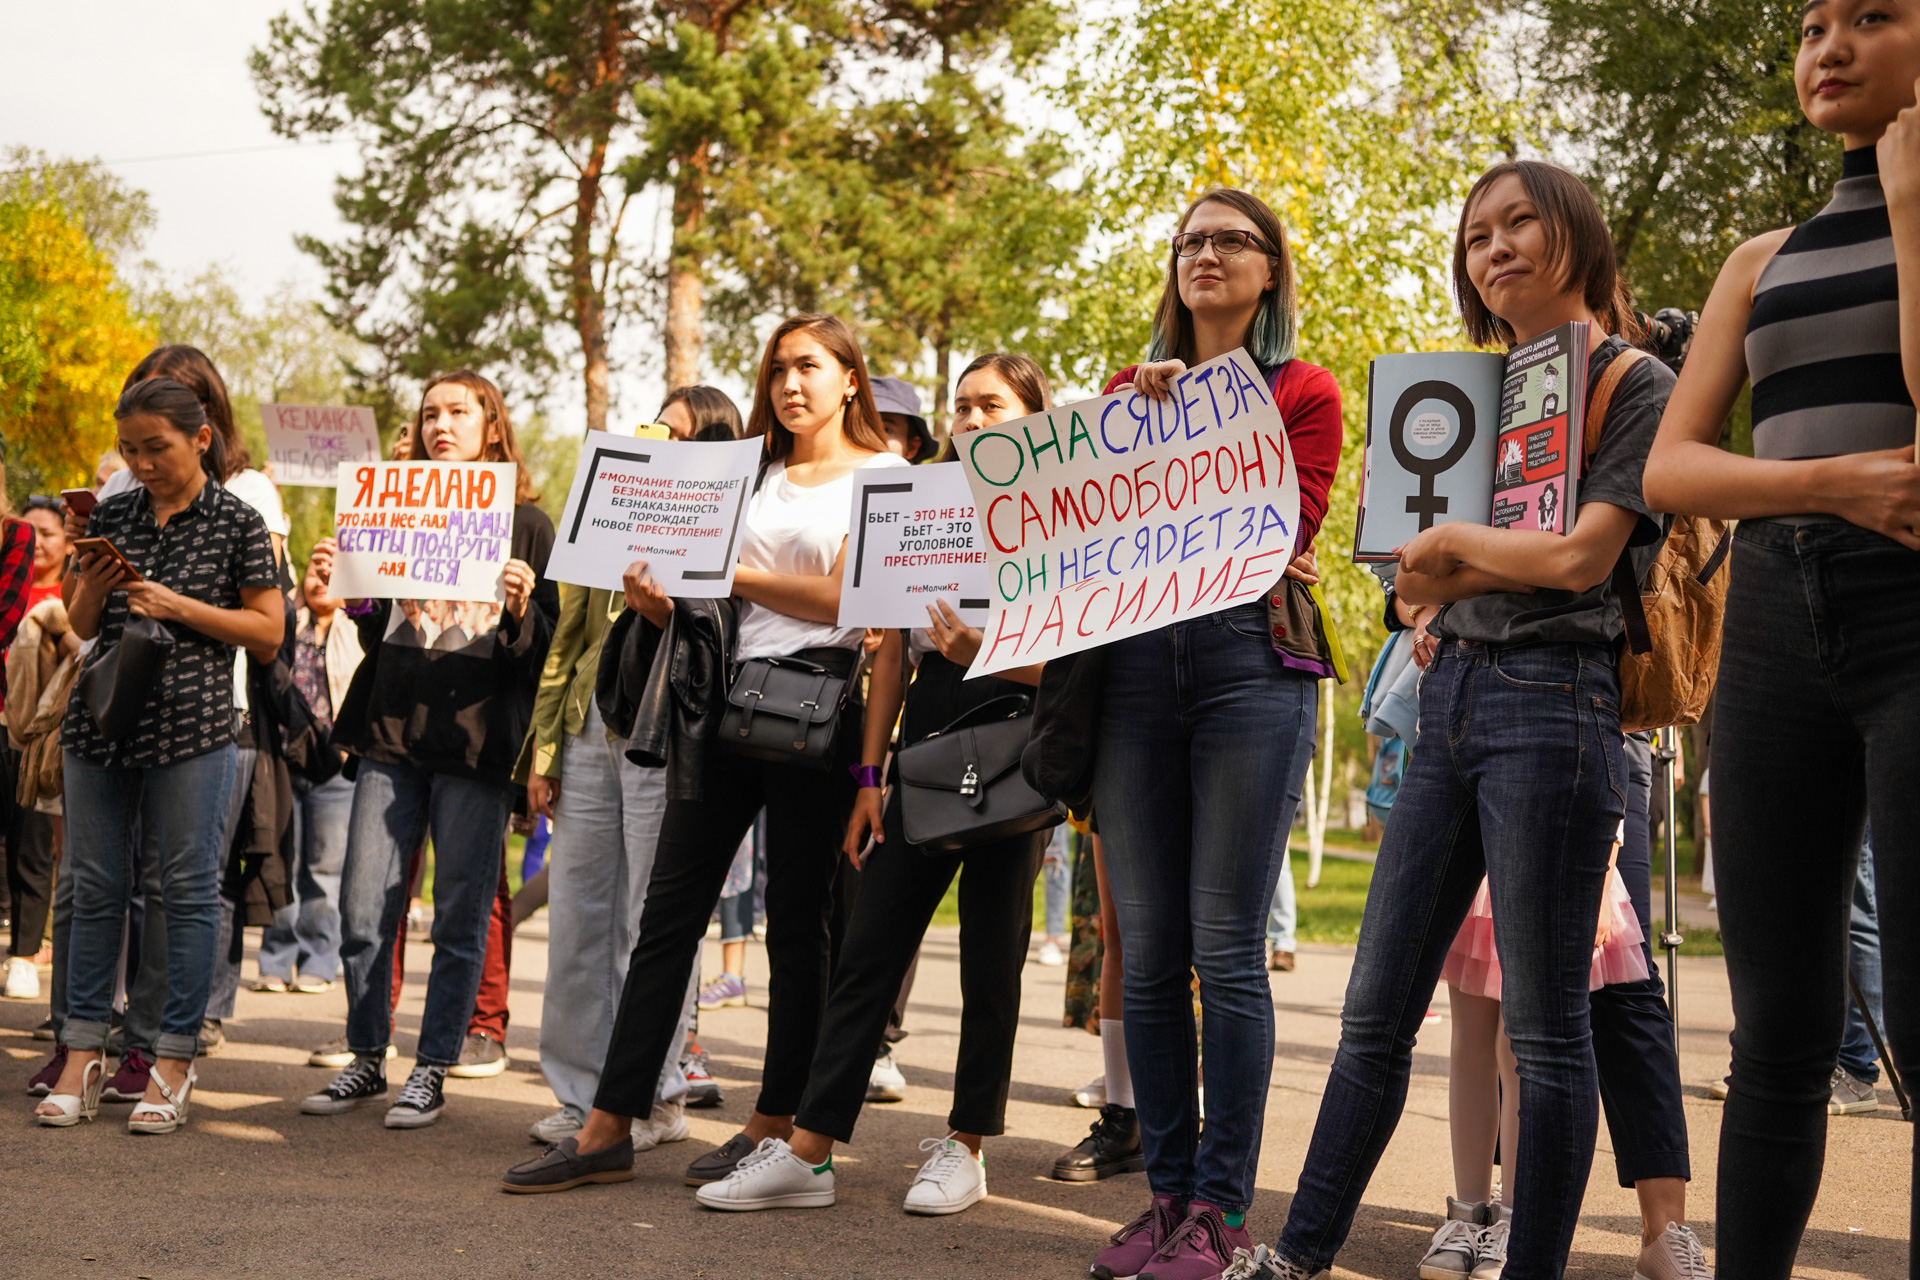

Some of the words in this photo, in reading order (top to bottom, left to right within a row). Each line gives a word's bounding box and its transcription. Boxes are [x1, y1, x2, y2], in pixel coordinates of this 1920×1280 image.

[276, 407, 365, 434] КЕЛИНКА
[970, 411, 1099, 486] ОНА
[1217, 356, 1268, 419] ЗА
[307, 434, 348, 452] ТОЖЕ
[353, 467, 375, 508] Я
[378, 467, 496, 510] ДЕЛАЮ
[599, 471, 674, 489] #МОЛЧАНИЕ
[676, 479, 740, 492] ПОРОЖДАЕТ
[612, 485, 725, 502] БЕЗНАКАЗАННОСТЬ!
[987, 429, 1287, 554] САМООБОРОНУ
[611, 497, 719, 514] БЕЗНАКАЗАННОСТЬ
[629, 511, 699, 526] ПОРОЖДАЕТ
[868, 512, 900, 523] БЬЕТ
[914, 509, 936, 522] ЭТО
[940, 508, 955, 520] НЕ
[959, 507, 974, 518] 12
[591, 518, 633, 532] НОВОЕ
[635, 524, 723, 538] ПРЕСТУПЛЕНИЕ!
[904, 525, 933, 537] БЬЕТ
[946, 522, 972, 534] ЭТО
[338, 528, 407, 557] СЕСТРЫ,
[627, 544, 688, 557] #НеМолчиKZ
[899, 537, 973, 552] УГОЛОВНОЕ
[884, 552, 987, 567] ПРЕСТУПЛЕНИЕ!
[998, 553, 1049, 602] ОН
[1060, 538, 1104, 589] НЕ
[1234, 504, 1289, 551] ЗА
[906, 583, 959, 594] #НеМолчиKZ
[984, 549, 1285, 667] НАСИЛИЕ
